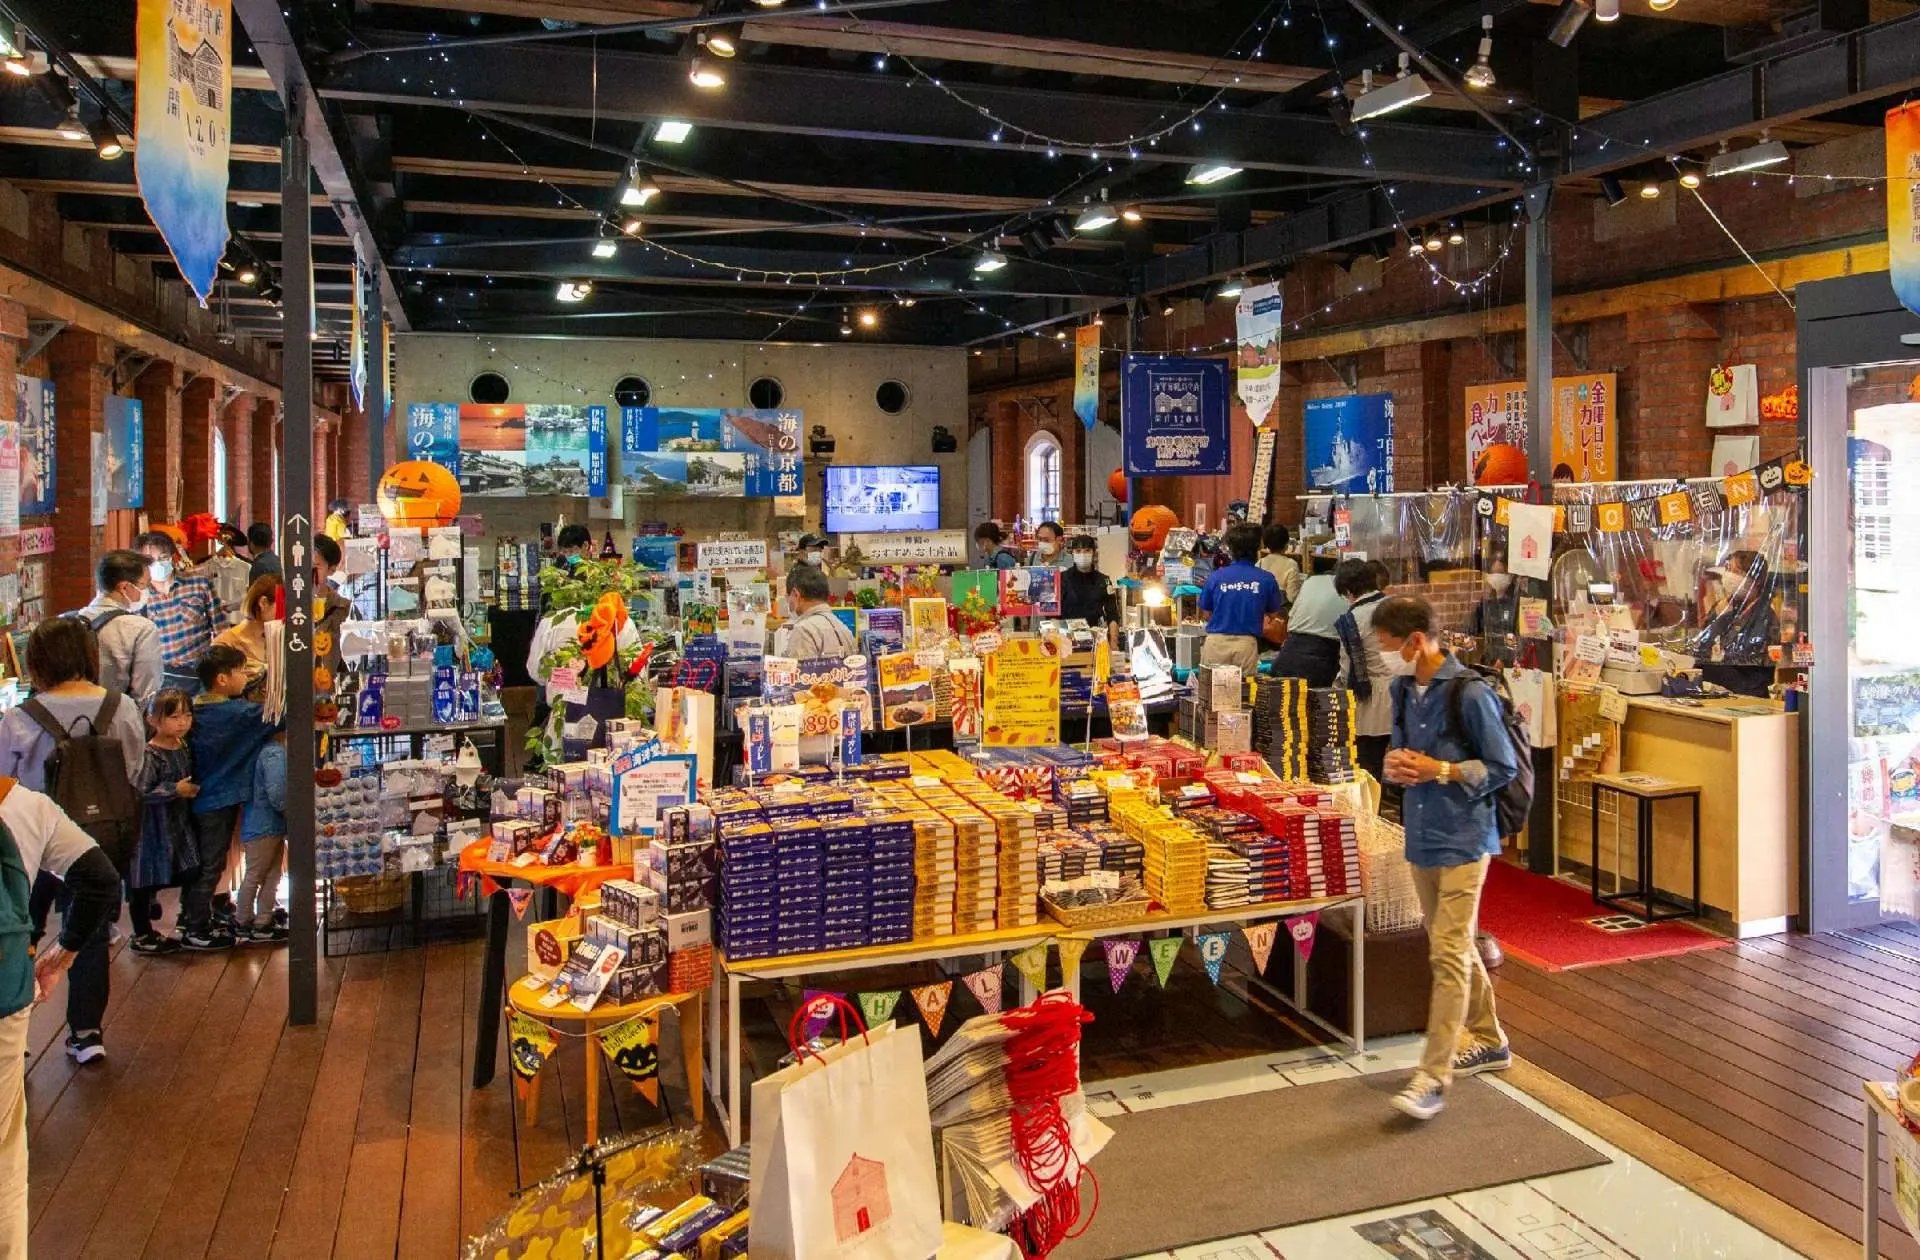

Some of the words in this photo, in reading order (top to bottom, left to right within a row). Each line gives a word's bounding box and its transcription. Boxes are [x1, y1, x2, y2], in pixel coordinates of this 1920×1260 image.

[777, 412, 798, 494] 海の京都
[1376, 438, 1385, 495] コーナー
